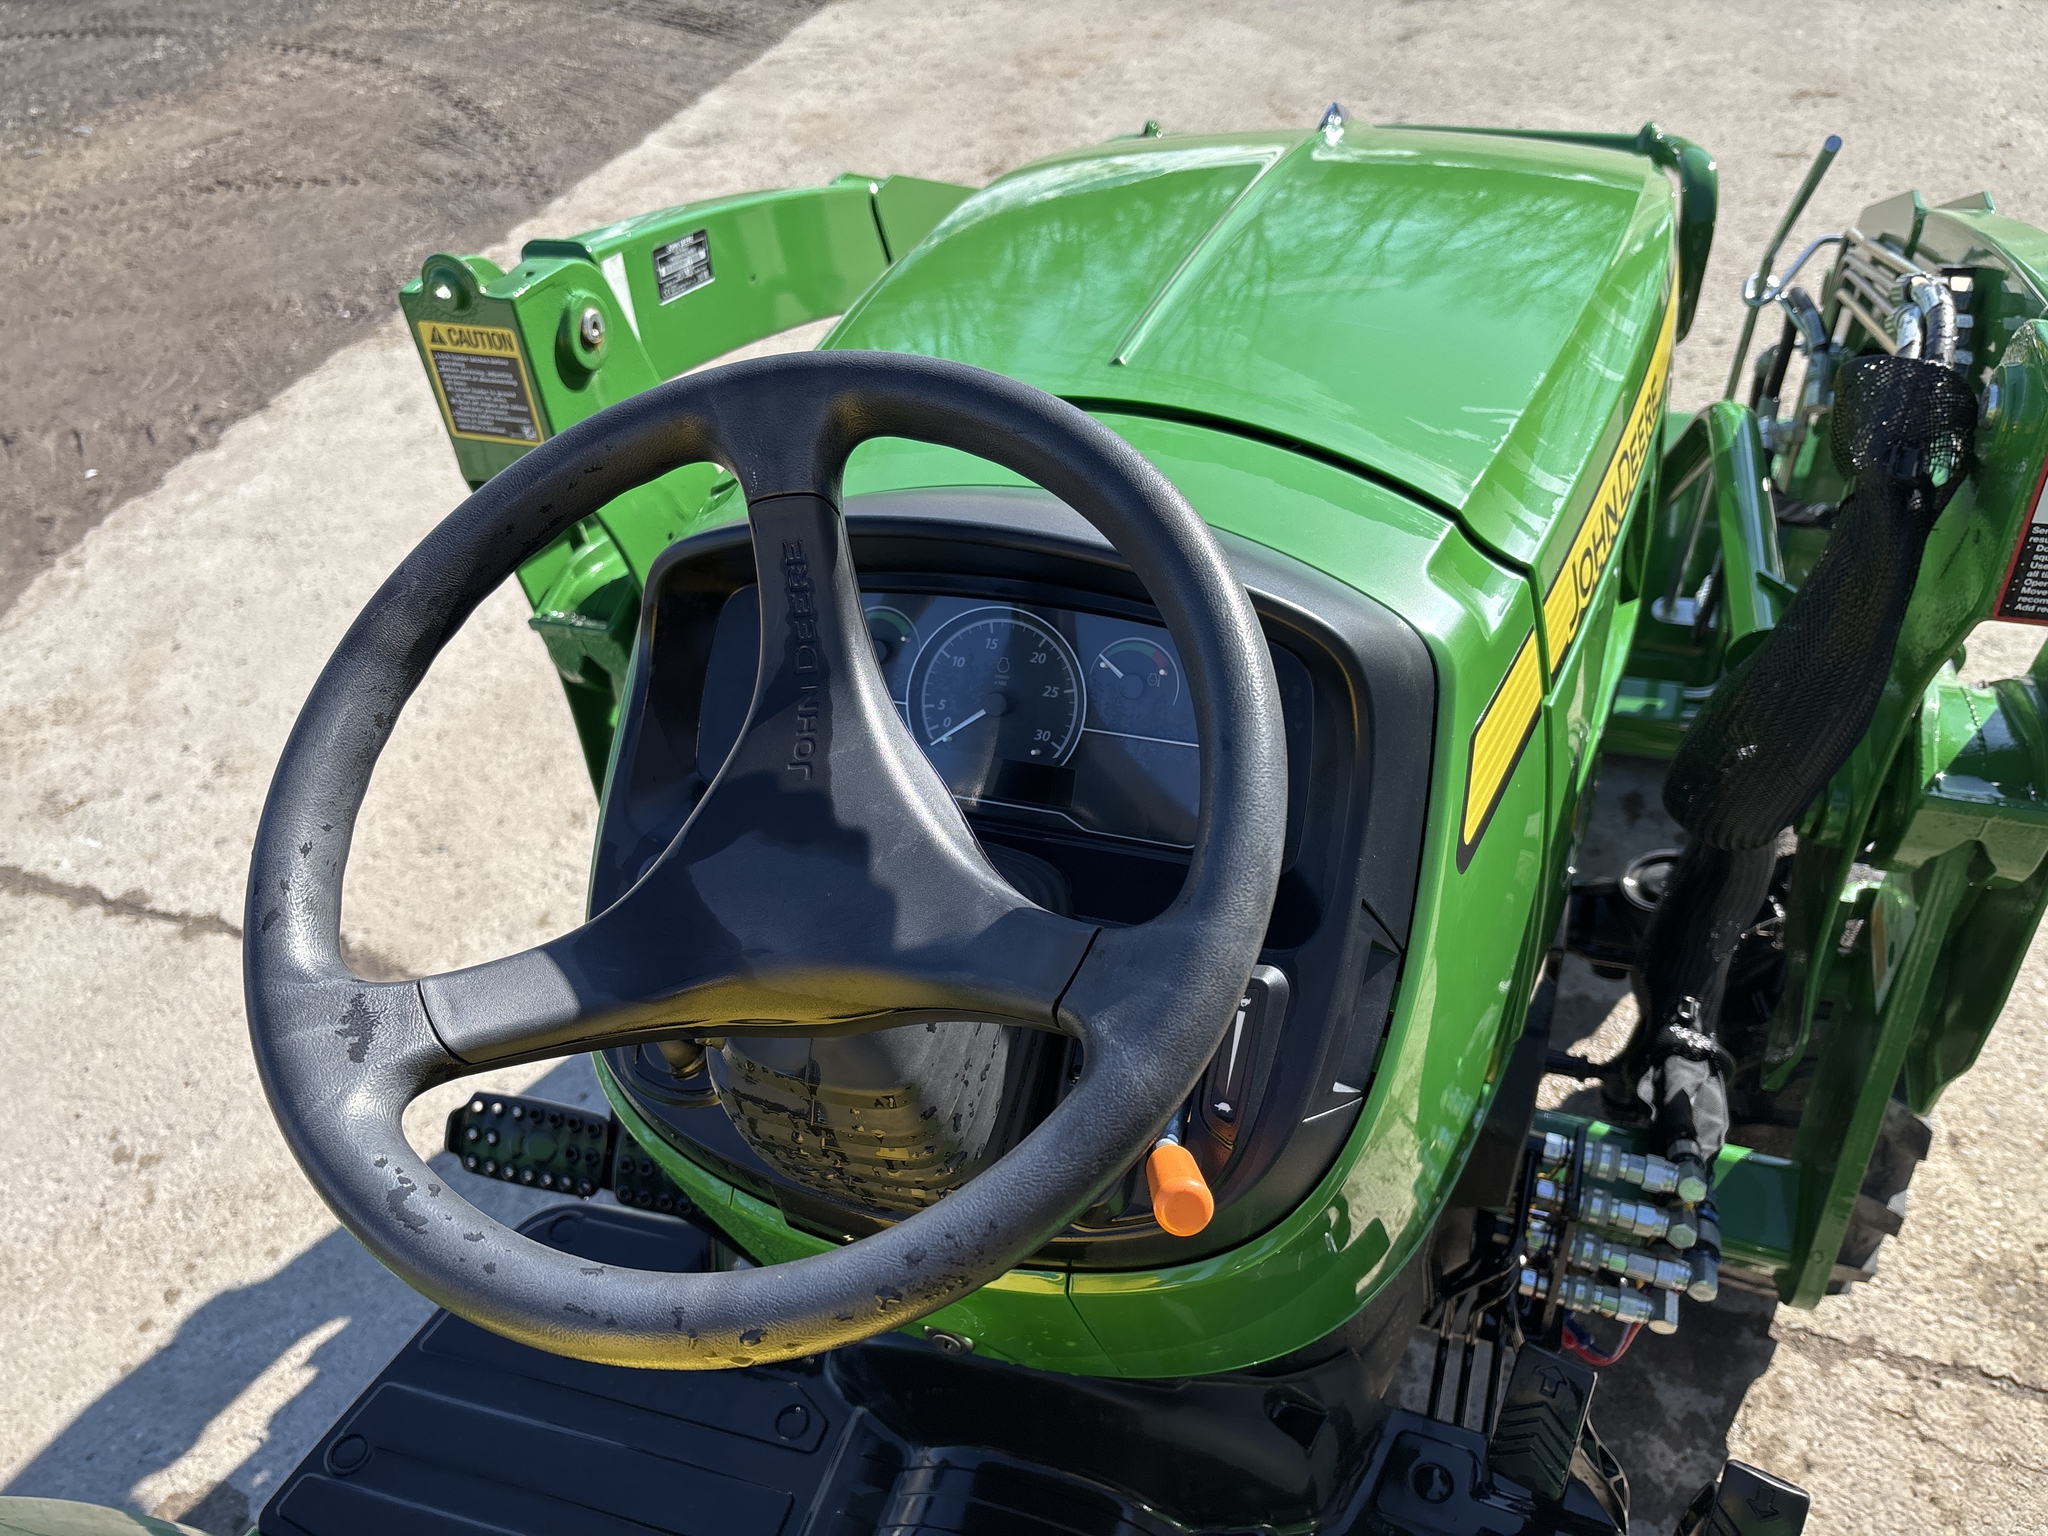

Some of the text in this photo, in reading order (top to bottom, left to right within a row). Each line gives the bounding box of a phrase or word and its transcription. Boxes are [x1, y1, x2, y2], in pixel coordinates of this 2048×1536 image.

[447, 326, 515, 352] CAUTION
[1568, 374, 1660, 629] JOHN DEERE
[2026, 570, 2040, 578] all
[2014, 604, 2036, 612] Add
[985, 637, 999, 650] 15
[781, 539, 820, 781] JOHN DEERE
[952, 655, 966, 668] 10
[1030, 652, 1047, 664] 20
[1042, 686, 1060, 698] 25
[937, 699, 947, 710] 5
[942, 716, 952, 728] 0
[1034, 729, 1051, 741] 30
